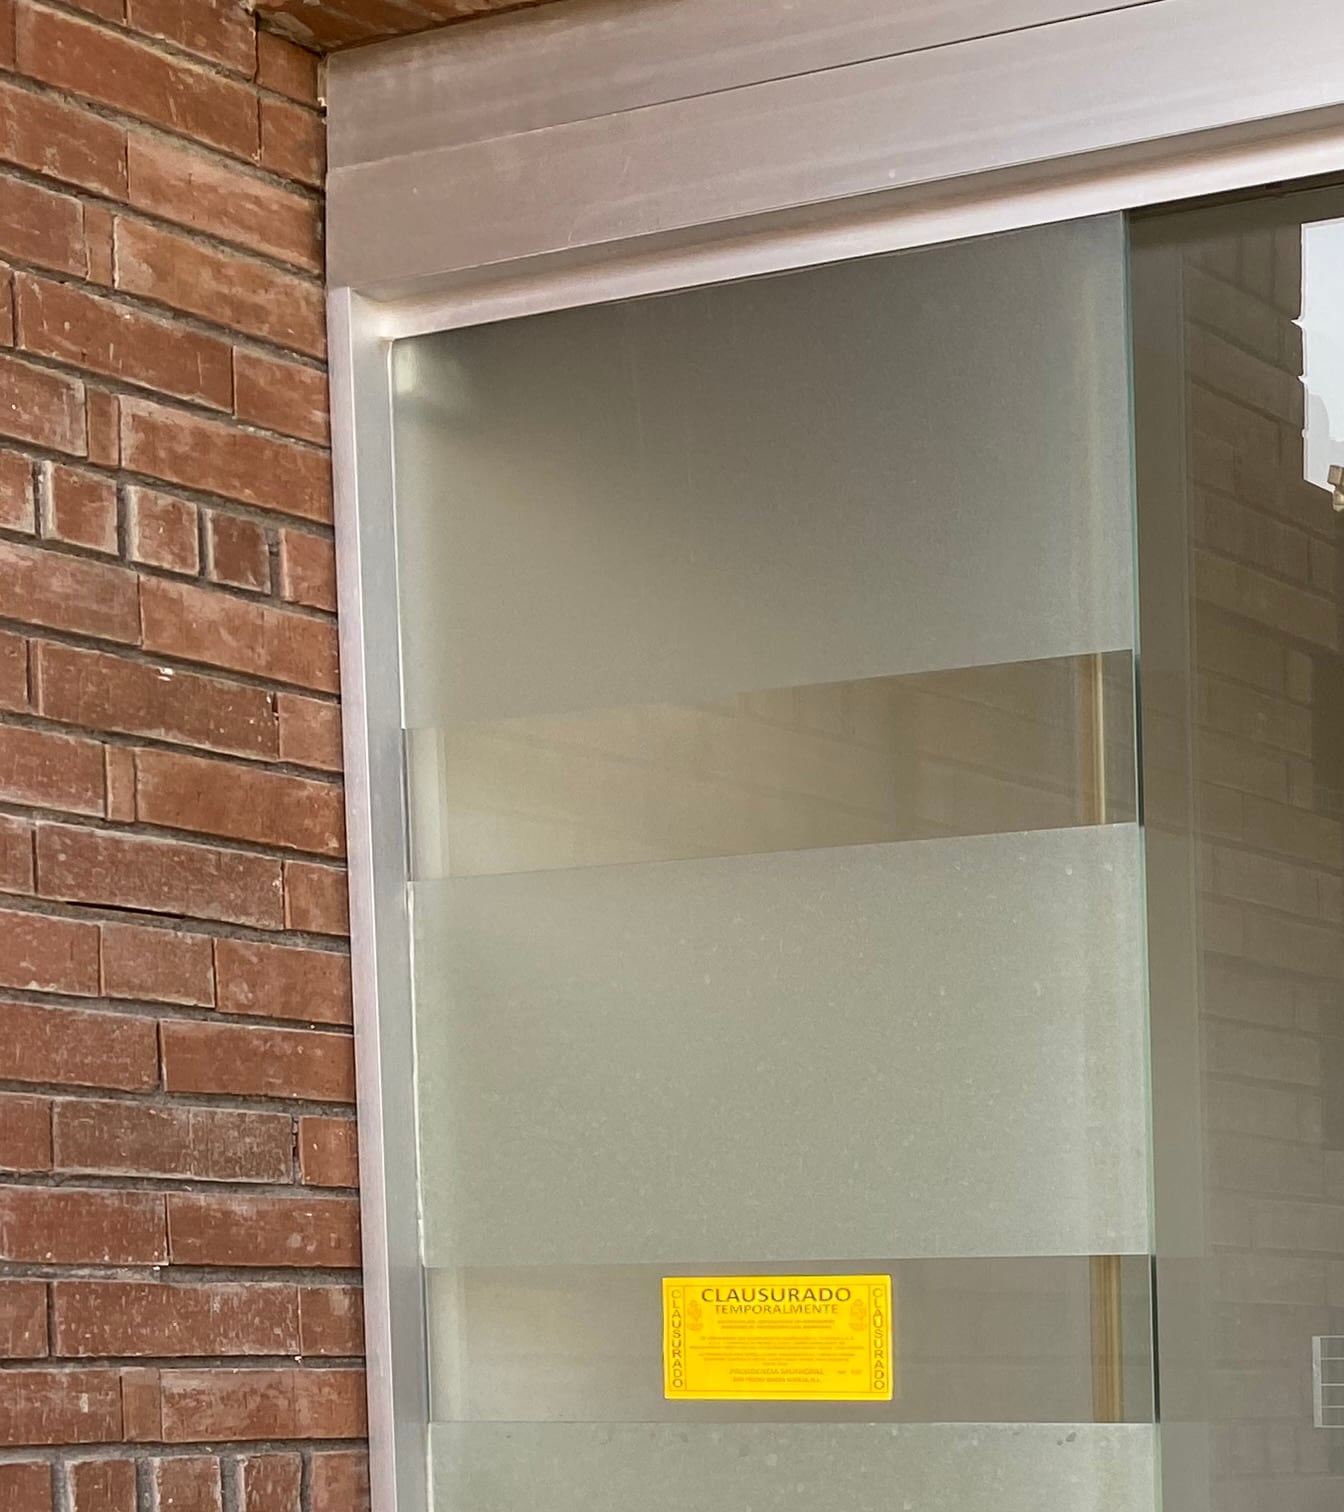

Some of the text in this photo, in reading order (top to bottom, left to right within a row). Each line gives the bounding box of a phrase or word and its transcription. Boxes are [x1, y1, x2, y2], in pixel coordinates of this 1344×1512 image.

[701, 1287, 852, 1303] CLAUSURADO
[715, 1303, 840, 1316] TEMPORALMENTE
[671, 1289, 684, 1389] CLAUSURADO
[872, 1288, 886, 1390] CLAUSURADO
